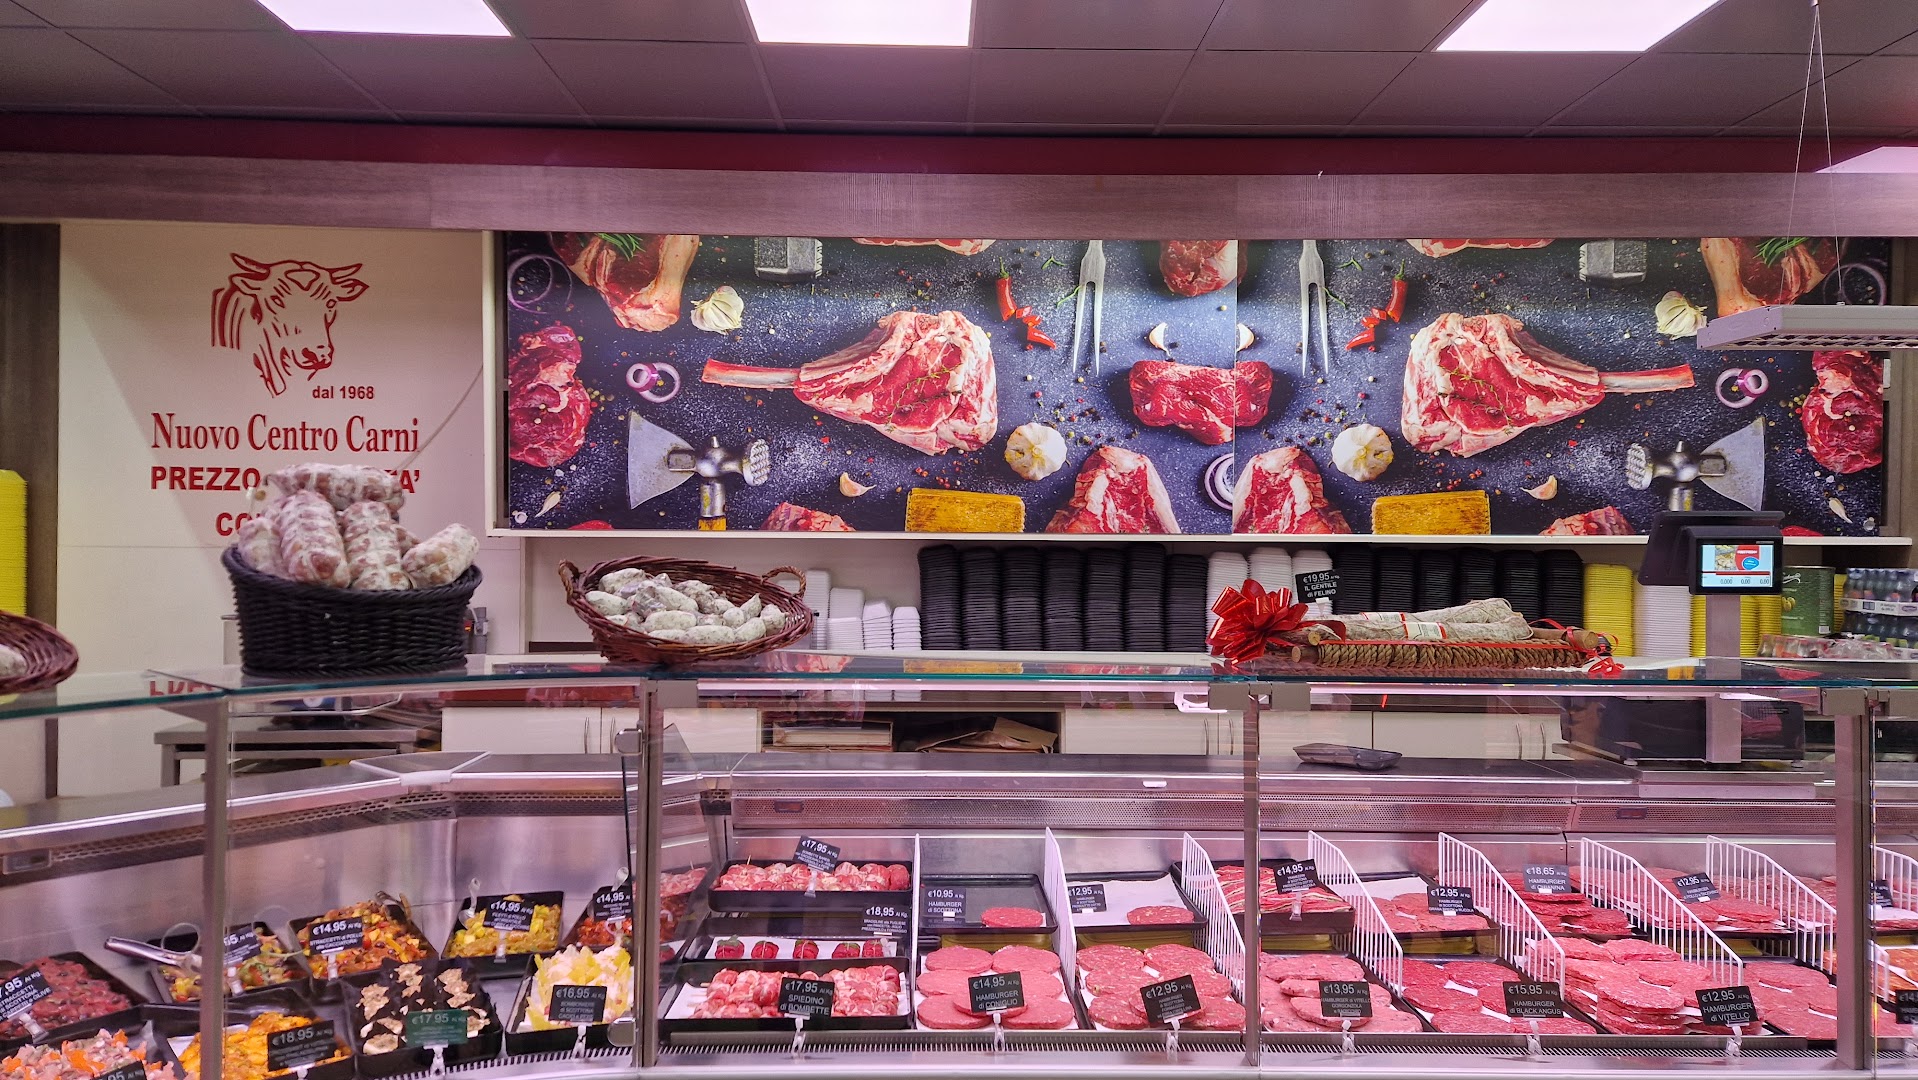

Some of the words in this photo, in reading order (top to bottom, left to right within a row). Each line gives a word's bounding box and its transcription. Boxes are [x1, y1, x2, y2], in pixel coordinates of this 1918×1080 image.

[312, 386, 334, 399] dal
[340, 386, 374, 399] 1968
[151, 412, 239, 449] Nuovo
[247, 414, 337, 451] Centro
[345, 415, 420, 452] Carni
[151, 466, 260, 491] PREZZO
[1303, 572, 1330, 583] €19,95
[1311, 582, 1338, 590] GENTILE
[1314, 588, 1337, 597] FELINO
[802, 840, 828, 854] €17,95
[1277, 864, 1304, 876] €14,95
[1526, 867, 1555, 876] €18,65
[596, 892, 624, 904] €14,95
[928, 890, 953, 898] €10,95
[1430, 888, 1459, 897] €12,95
[491, 900, 520, 912] €14,95
[866, 906, 894, 917] €18,95
[313, 921, 347, 935] €14,95
[785, 980, 818, 993] €17,95
[973, 976, 1005, 989] €14,95
[556, 987, 590, 999] €16,95
[1146, 982, 1178, 998] €12,95
[1324, 984, 1355, 994] €13,95
[1508, 984, 1543, 995] €15,95
[788, 994, 824, 1005] SPIEDINO
[976, 990, 1019, 1001] HAMBURGER
[1702, 990, 1735, 1002] €12,95
[788, 1003, 829, 1015] BOMBETTE
[1703, 1003, 1752, 1013] HAMBURGER
